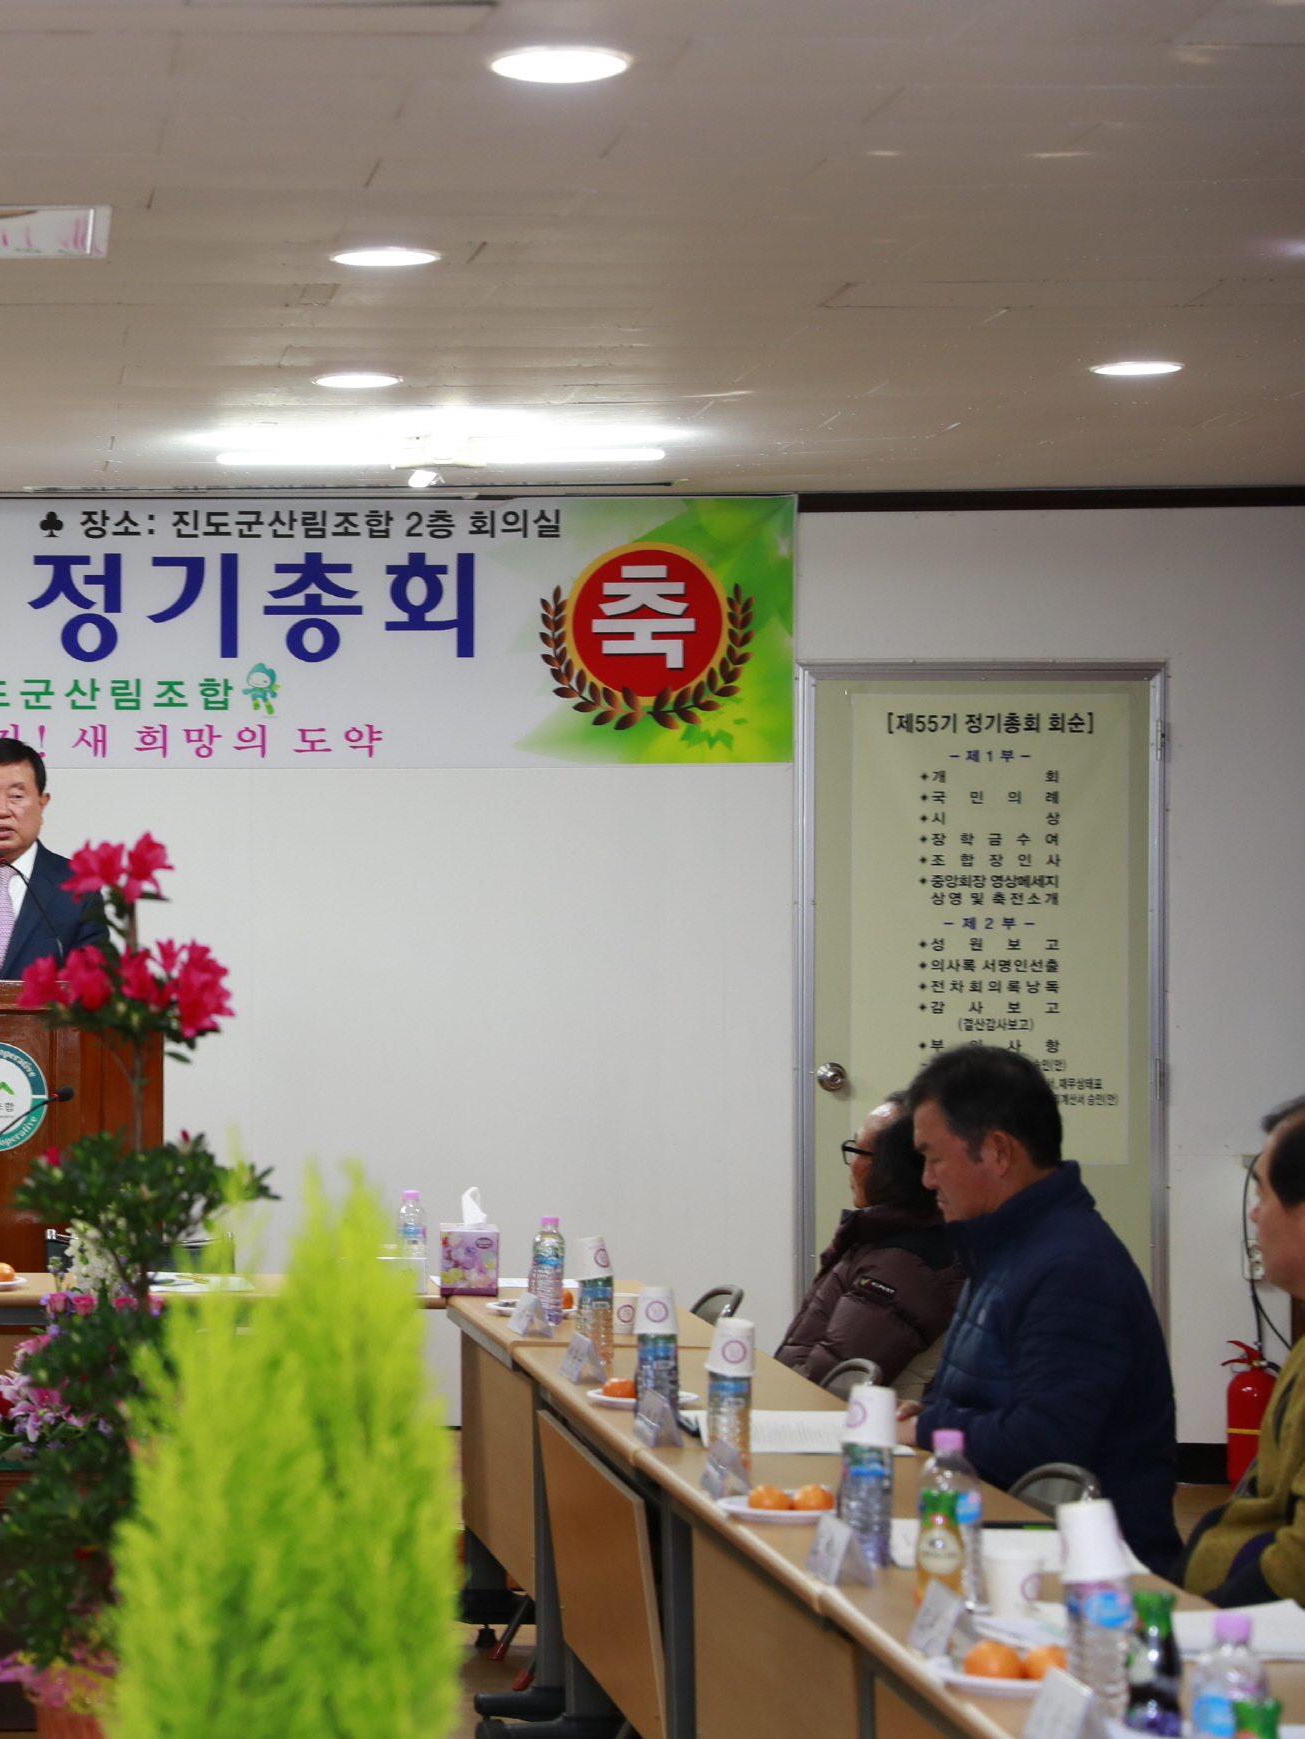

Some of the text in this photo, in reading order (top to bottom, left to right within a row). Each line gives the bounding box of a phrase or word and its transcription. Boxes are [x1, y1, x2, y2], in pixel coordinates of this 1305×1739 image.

[80, 509, 560, 539] 장소: 진도군산림조합 2층 회의실
[28, 552, 475, 662] 정기총회
[591, 563, 697, 670] 축
[888, 712, 1093, 734] [제55기 정기총회 회순]
[73, 724, 106, 758] 새
[135, 724, 266, 758] 희망의
[294, 724, 382, 758] 도약
[931, 875, 986, 888] 중앙회장
[932, 892, 1058, 905] 상영 및 축전소개
[931, 959, 975, 972] 의사록
